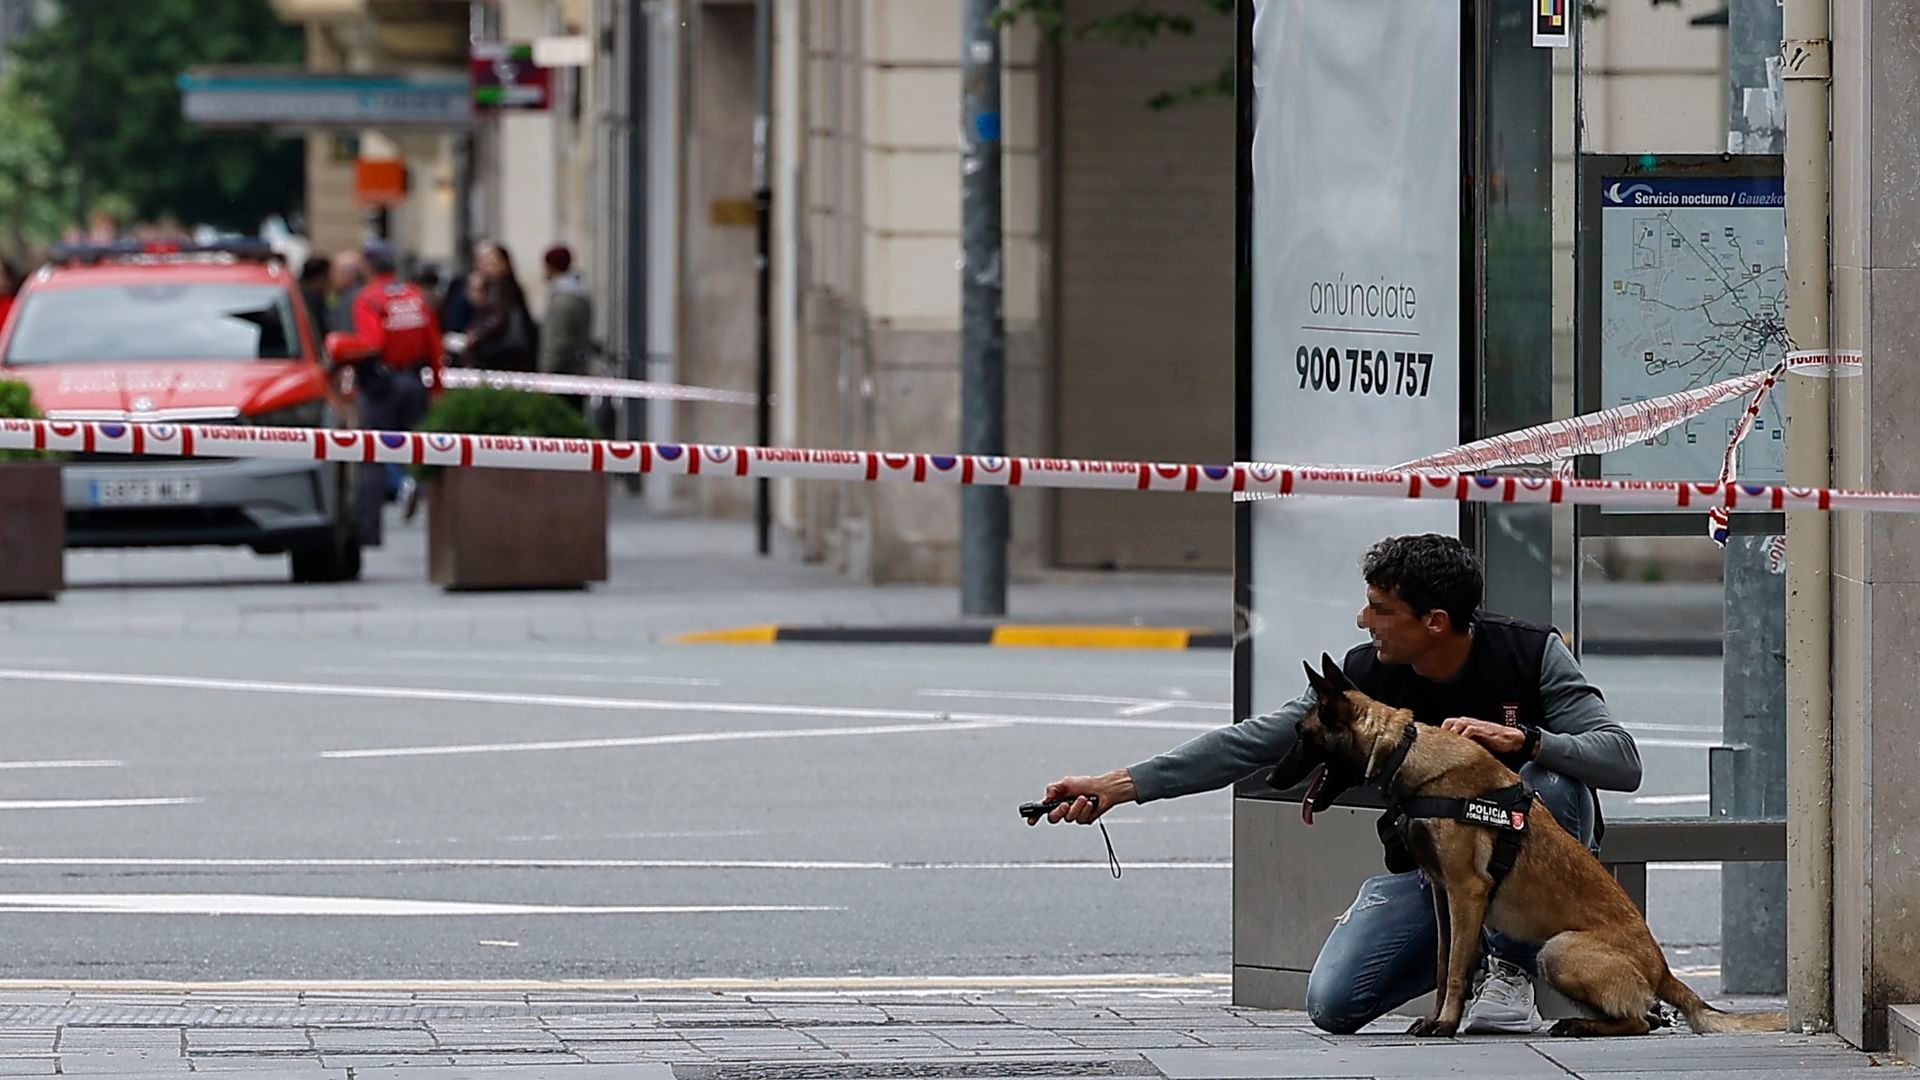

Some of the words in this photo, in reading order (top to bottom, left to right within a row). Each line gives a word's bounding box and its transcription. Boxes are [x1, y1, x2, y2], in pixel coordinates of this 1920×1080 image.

[1634, 191, 1679, 205] Servicio
[1681, 191, 1729, 205] nocturno
[1737, 191, 1784, 205] Gauezko
[1310, 272, 1416, 319] anúnciate
[1296, 345, 1341, 392] 900
[1345, 348, 1389, 396] 750
[1394, 351, 1434, 398] 757
